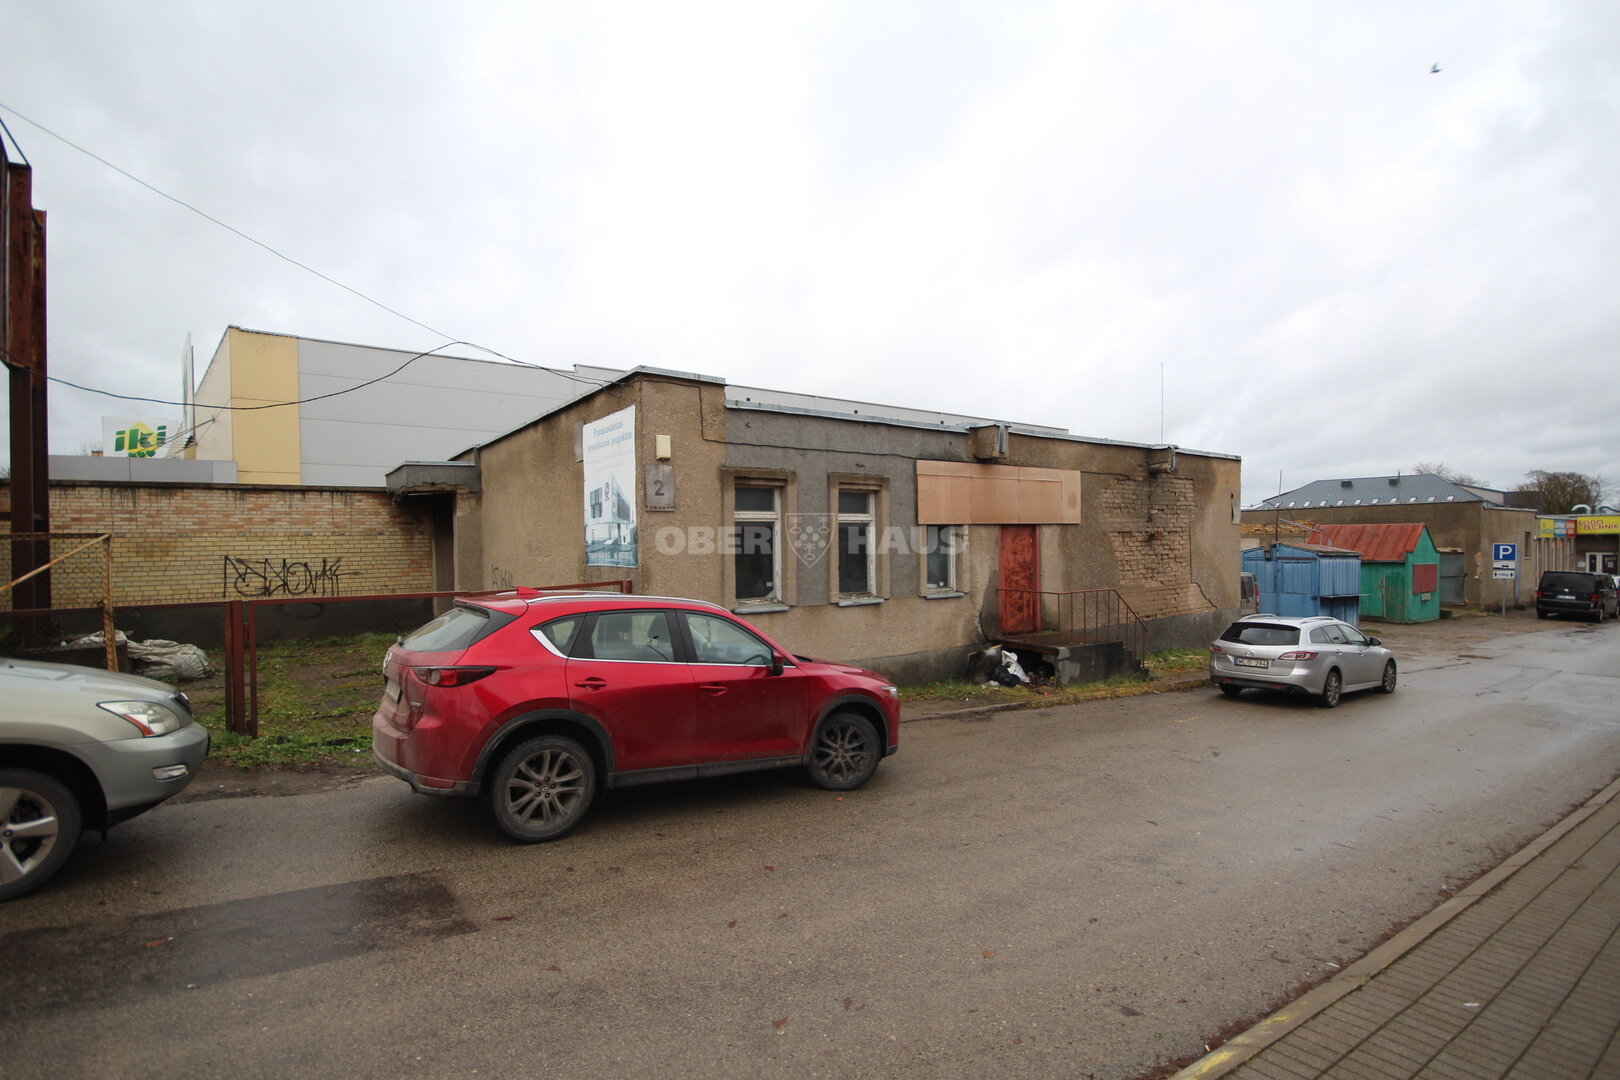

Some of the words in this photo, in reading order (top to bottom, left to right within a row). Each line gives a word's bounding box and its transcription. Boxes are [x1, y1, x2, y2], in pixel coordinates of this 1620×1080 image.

[115, 425, 167, 452] iki
[654, 480, 664, 496] 2
[1499, 545, 1513, 560] P
